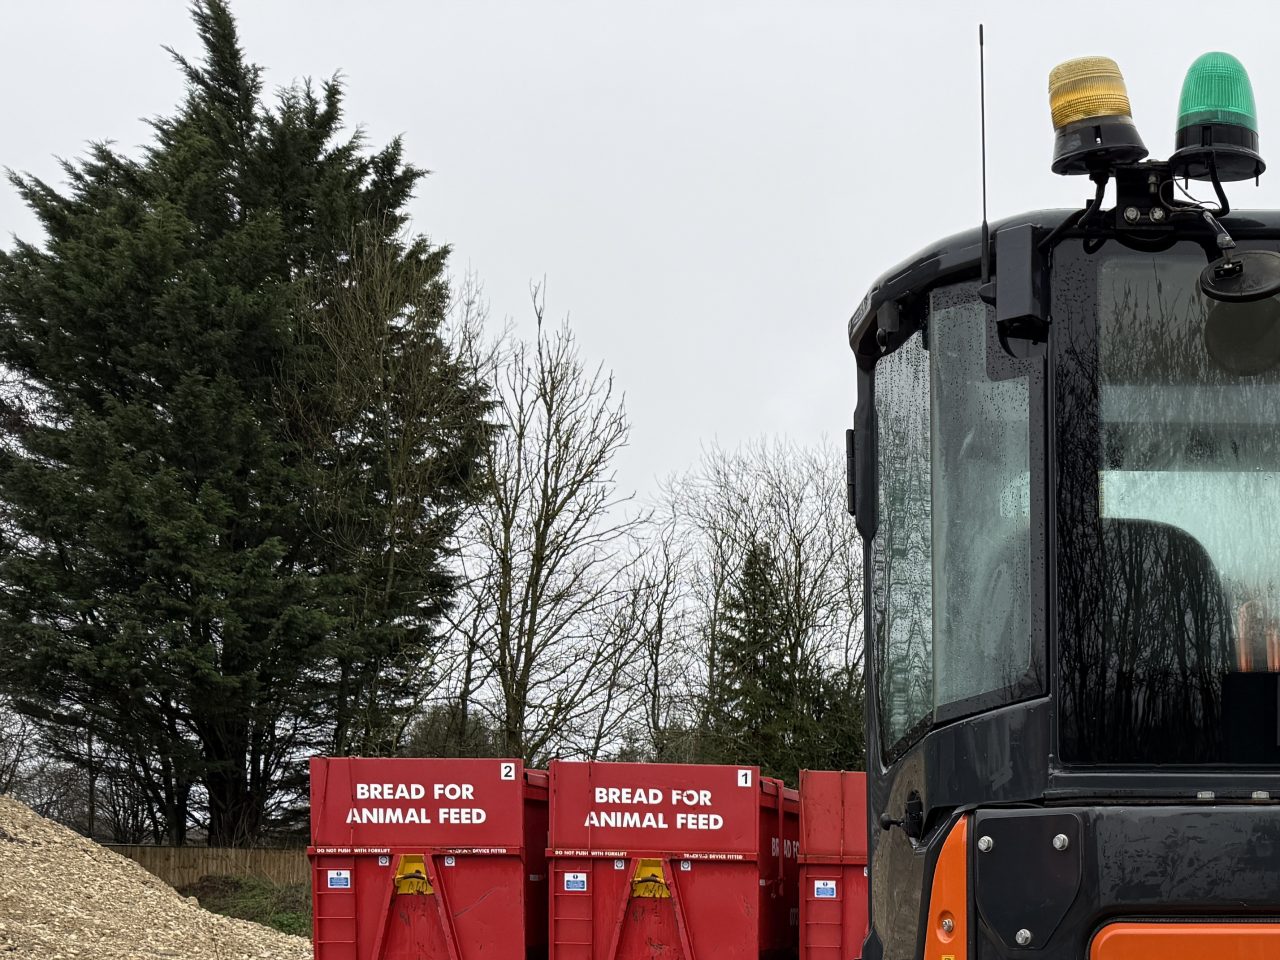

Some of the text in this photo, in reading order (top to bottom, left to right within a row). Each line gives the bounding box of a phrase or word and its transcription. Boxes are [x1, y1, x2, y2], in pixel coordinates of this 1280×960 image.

[503, 765, 513, 778] 2
[356, 783, 475, 800] BREAD FOR
[595, 787, 712, 806] BREAD FOR
[345, 807, 487, 824] ANIMAL FEED
[583, 811, 724, 830] ANIMAL FEED
[771, 837, 792, 858] BRAD
